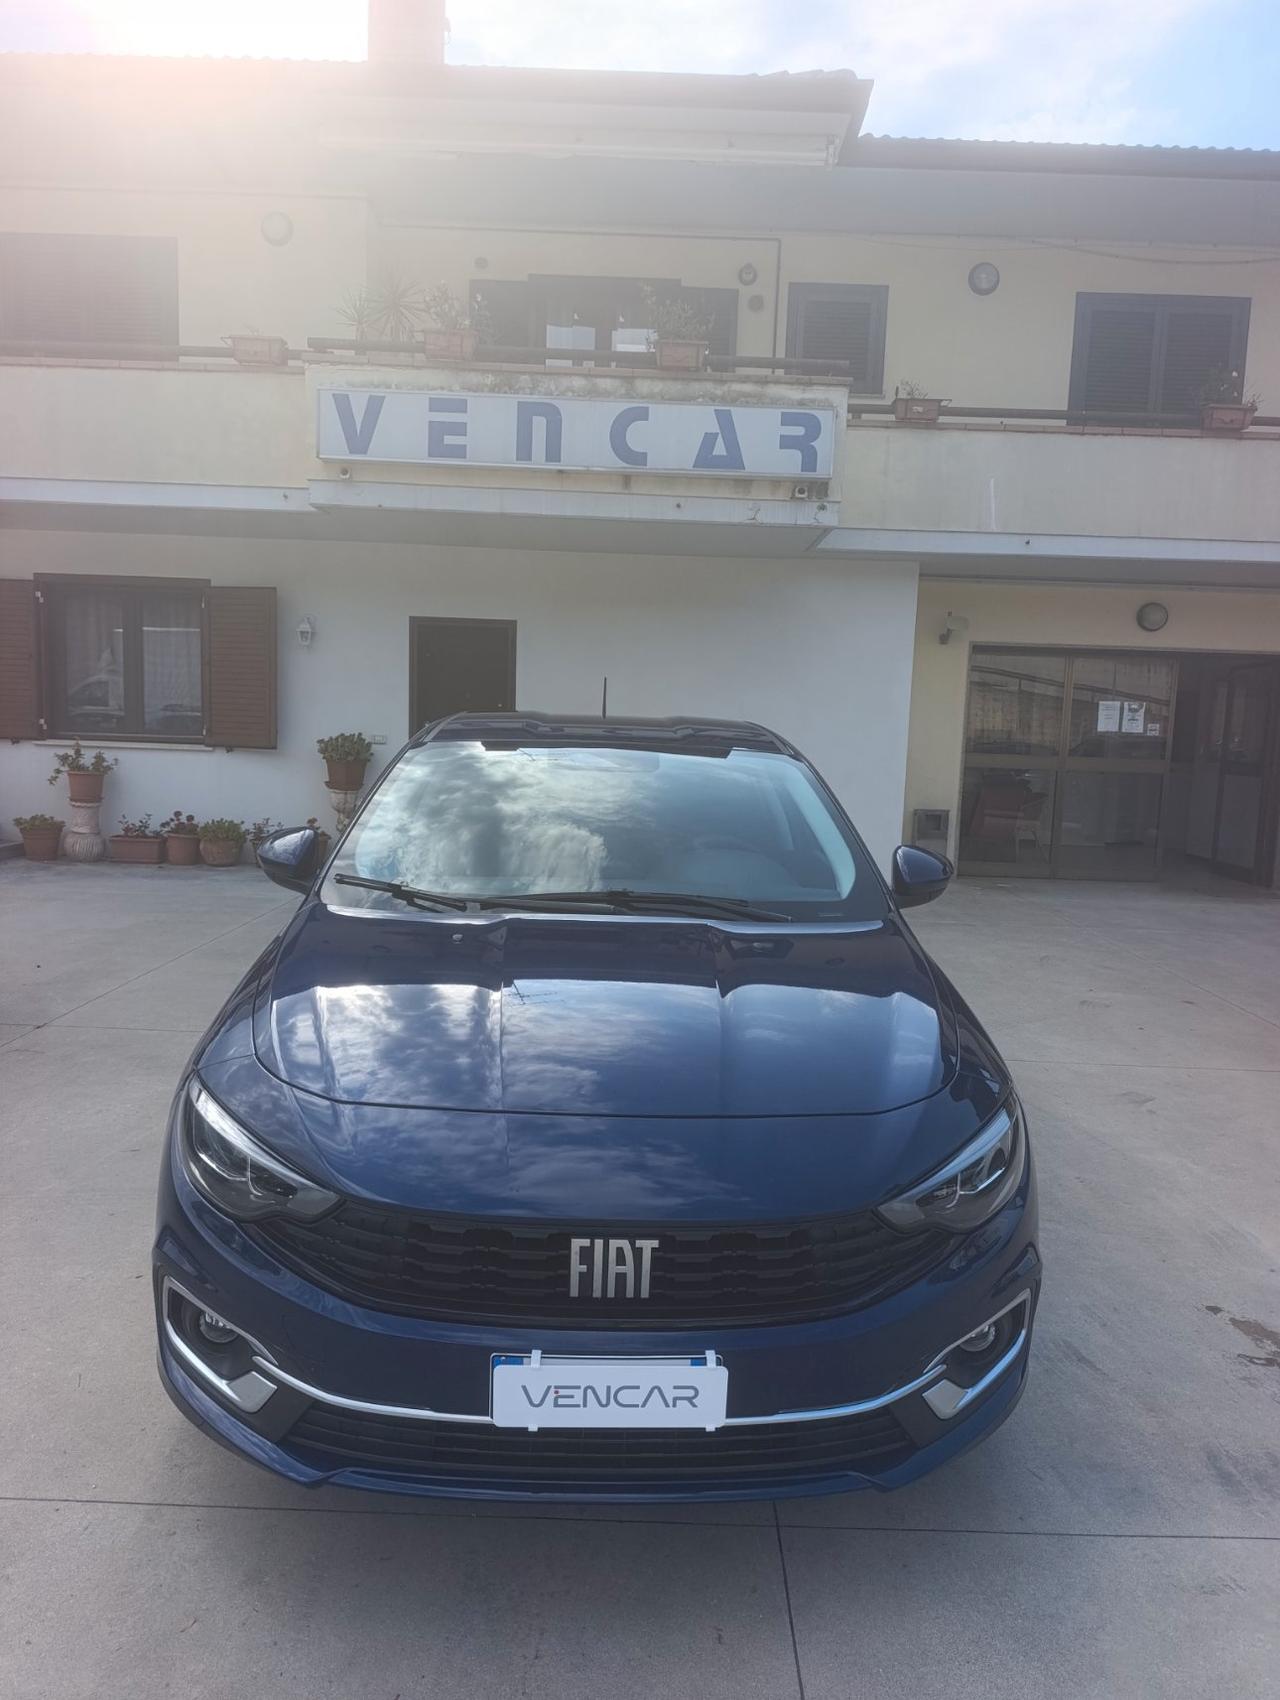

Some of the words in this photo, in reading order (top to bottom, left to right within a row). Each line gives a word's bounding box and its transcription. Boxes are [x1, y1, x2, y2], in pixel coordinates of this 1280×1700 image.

[332, 393, 822, 473] VENCAR
[569, 1238, 660, 1299] FIAT
[521, 1384, 700, 1409] VENCAR
